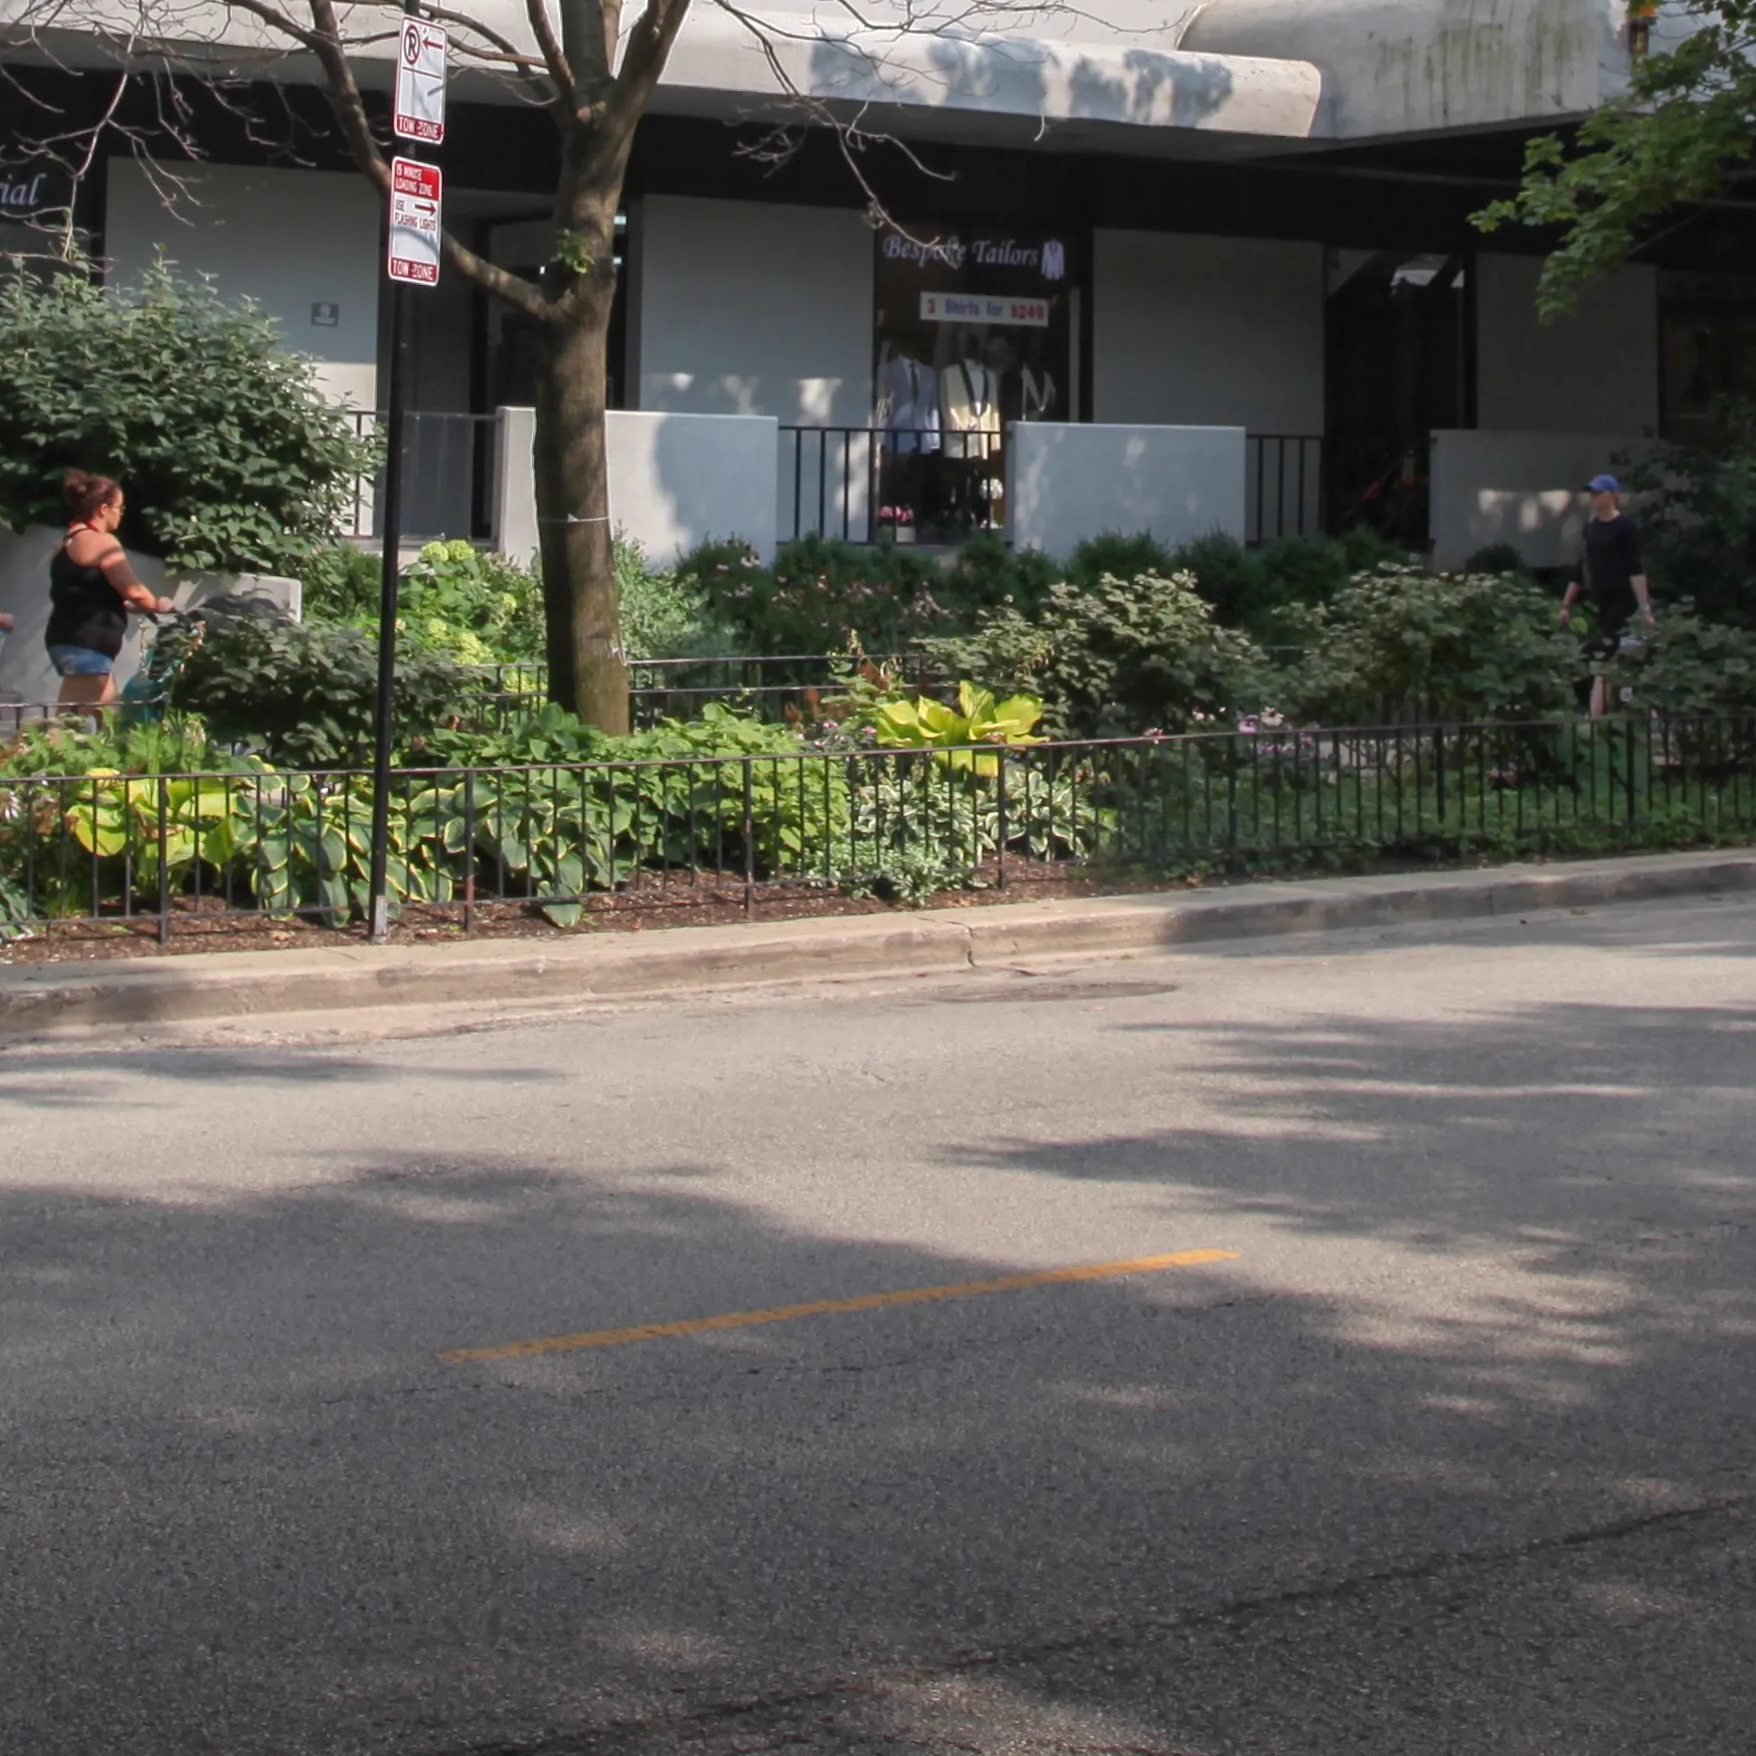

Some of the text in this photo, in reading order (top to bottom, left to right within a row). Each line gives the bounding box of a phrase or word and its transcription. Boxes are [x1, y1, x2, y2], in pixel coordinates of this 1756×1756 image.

[398, 116, 439, 139] TOW ZONE
[395, 177, 433, 197] LOADING ZONE
[883, 234, 1040, 268] Bespoke Tailors
[392, 259, 434, 281] TOW ZONE
[927, 298, 936, 315] 3
[945, 297, 981, 316] Shirts
